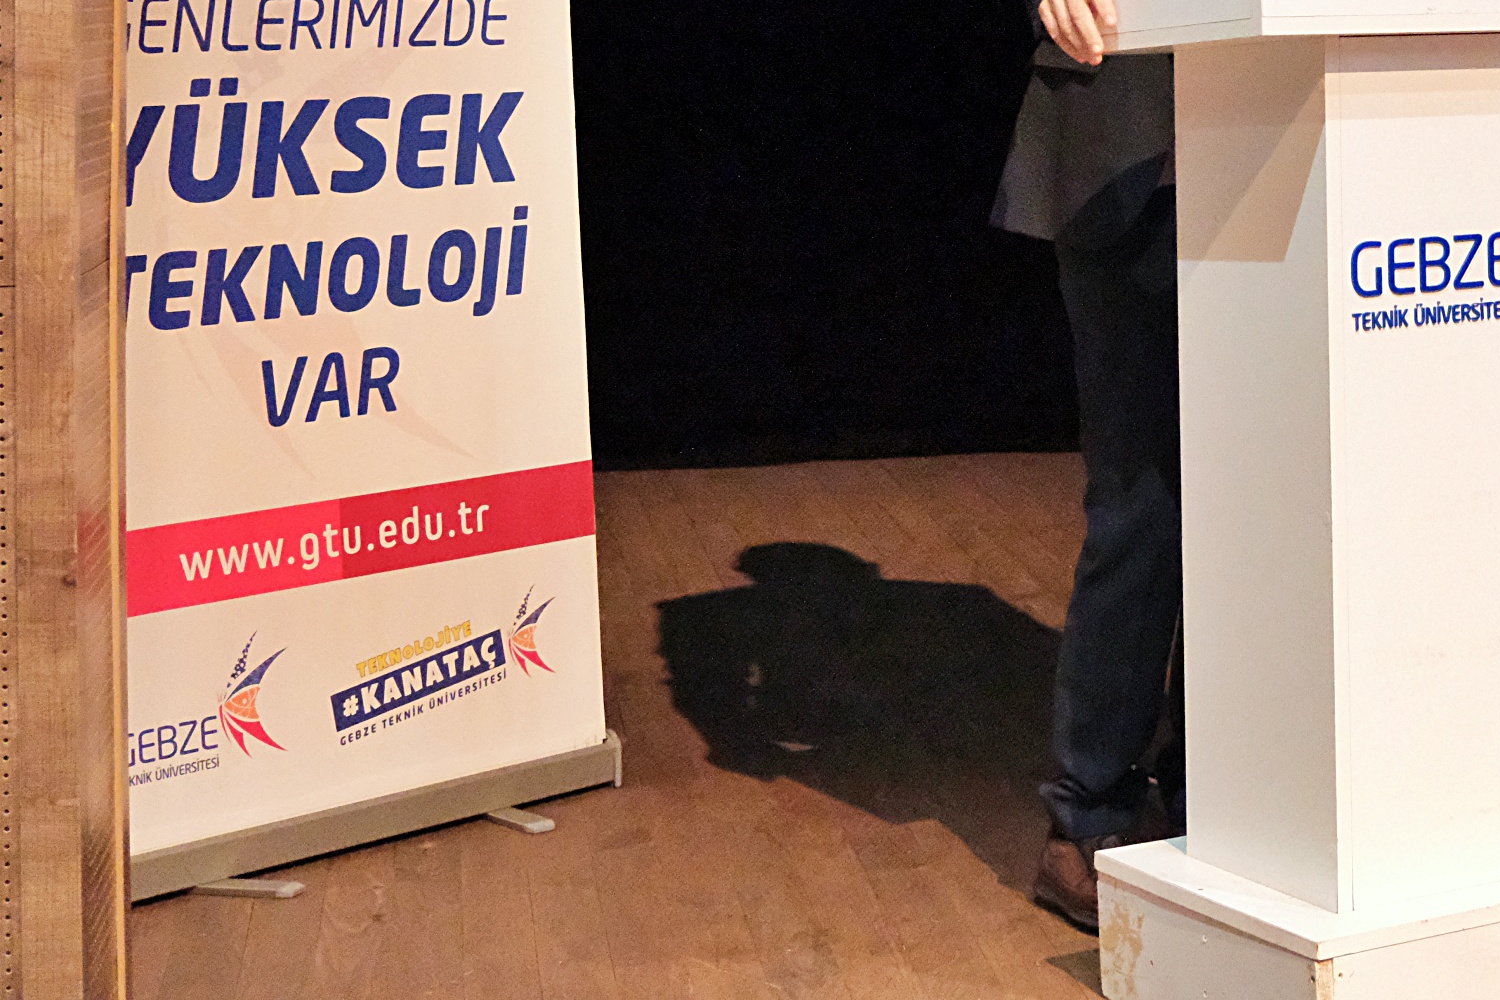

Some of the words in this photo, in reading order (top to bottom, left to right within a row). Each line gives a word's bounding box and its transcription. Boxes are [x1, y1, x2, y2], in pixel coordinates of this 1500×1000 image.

[1352, 304, 1409, 332] TEKNİK
[261, 347, 400, 428] VAR
[179, 501, 490, 582] www.gtu.edu.tr
[342, 636, 497, 718] #KANATAÇ
[355, 619, 473, 678] TEKNOLOJİYE
[340, 723, 377, 746] GEBZE
[381, 703, 424, 730] TEKNİK
[428, 668, 507, 710] ÜNİVERSİTESİ
[128, 769, 152, 788] KNİK
[155, 753, 220, 782] ÜNİVERSİTESİ
